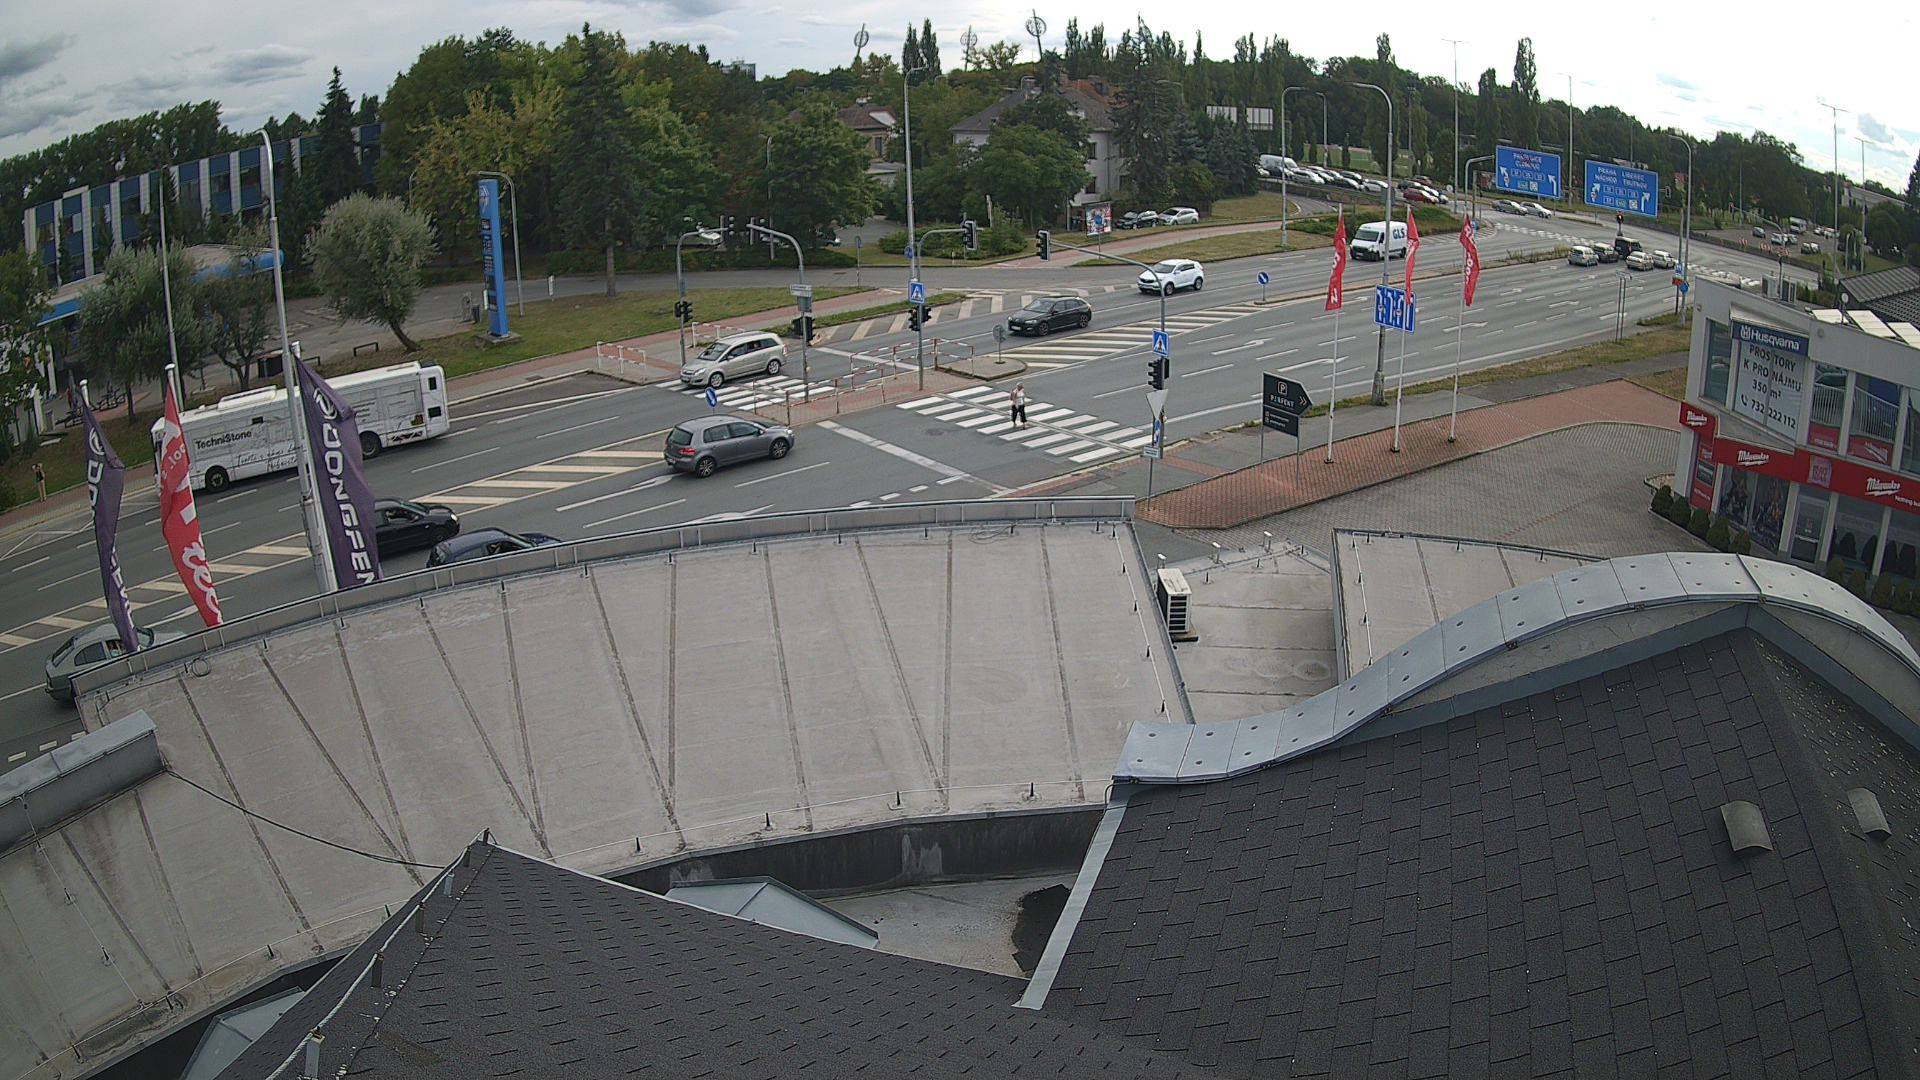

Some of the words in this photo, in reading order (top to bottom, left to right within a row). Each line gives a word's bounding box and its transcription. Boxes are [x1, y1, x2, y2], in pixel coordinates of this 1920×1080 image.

[1393, 228, 1405, 240] GLS
[1750, 329, 1800, 351] Husqvarna
[1743, 359, 1750, 370] K
[1752, 379, 1768, 394] 350
[1751, 399, 1766, 414] 732
[195, 430, 252, 450] TechniStone
